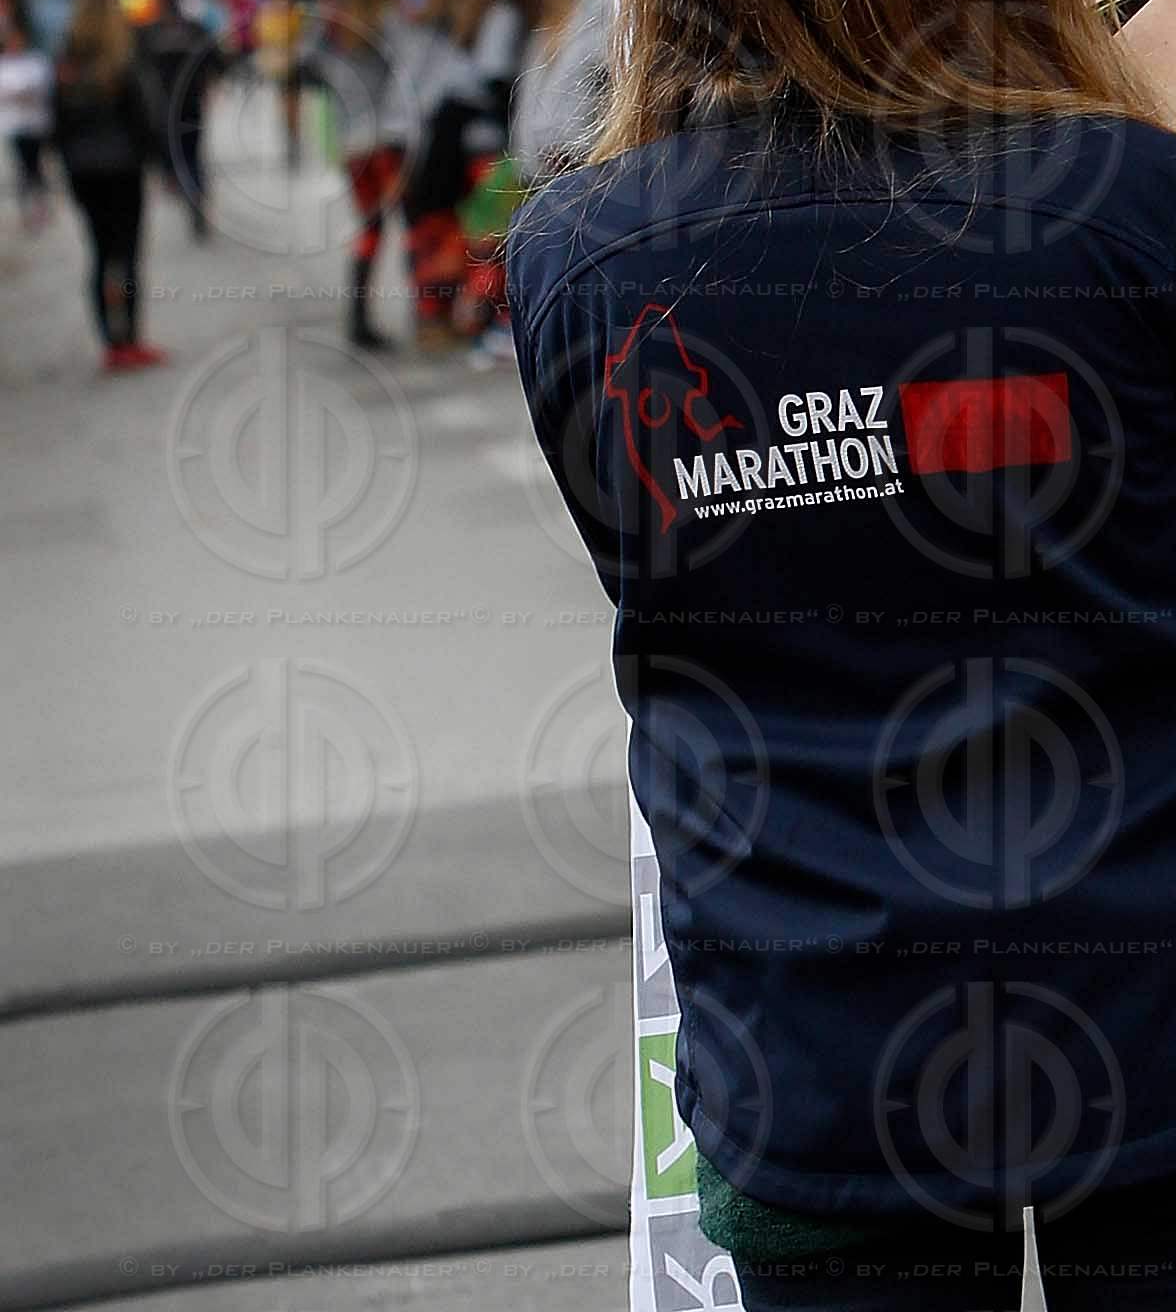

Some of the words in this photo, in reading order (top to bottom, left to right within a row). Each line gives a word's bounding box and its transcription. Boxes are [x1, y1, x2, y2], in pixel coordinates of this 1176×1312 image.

[778, 386, 888, 437] GRAZ
[673, 435, 899, 500] MARATHON
[694, 478, 905, 520] www.grazmarathon.at
